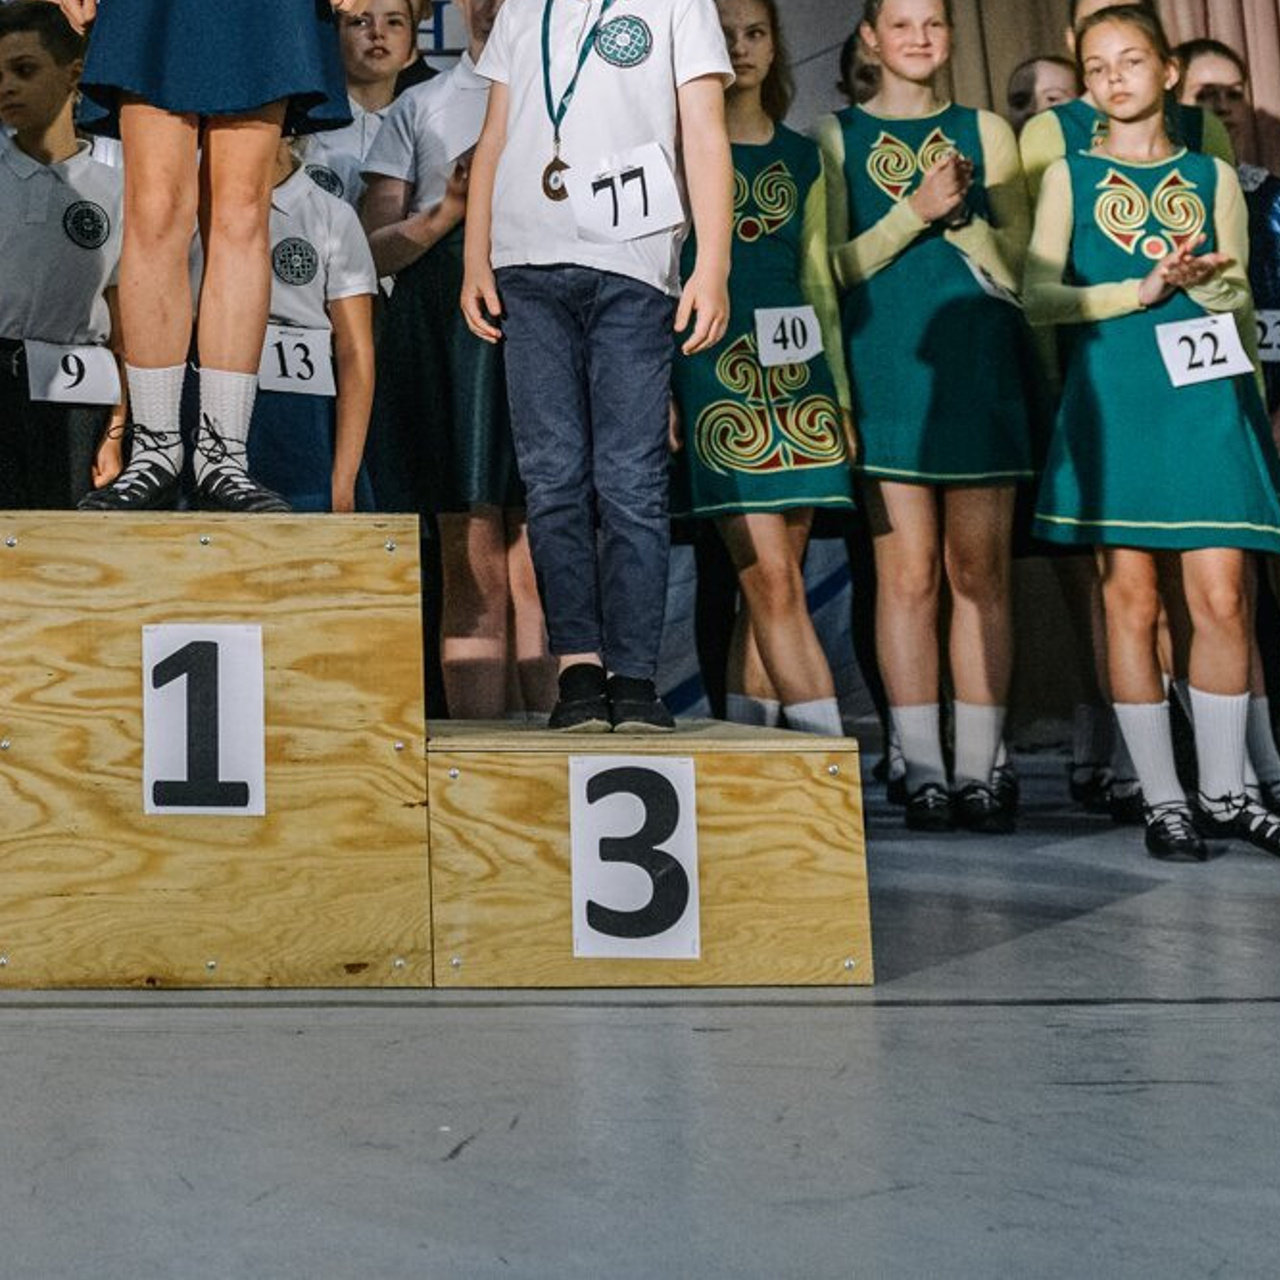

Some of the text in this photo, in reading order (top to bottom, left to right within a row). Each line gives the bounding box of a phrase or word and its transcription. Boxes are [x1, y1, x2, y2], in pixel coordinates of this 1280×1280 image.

[591, 166, 648, 227] 77
[772, 316, 808, 350] 40
[1177, 331, 1228, 370] 22
[61, 353, 86, 390] 9
[272, 340, 315, 380] 13
[152, 640, 250, 808] 1
[585, 766, 690, 939] 3
